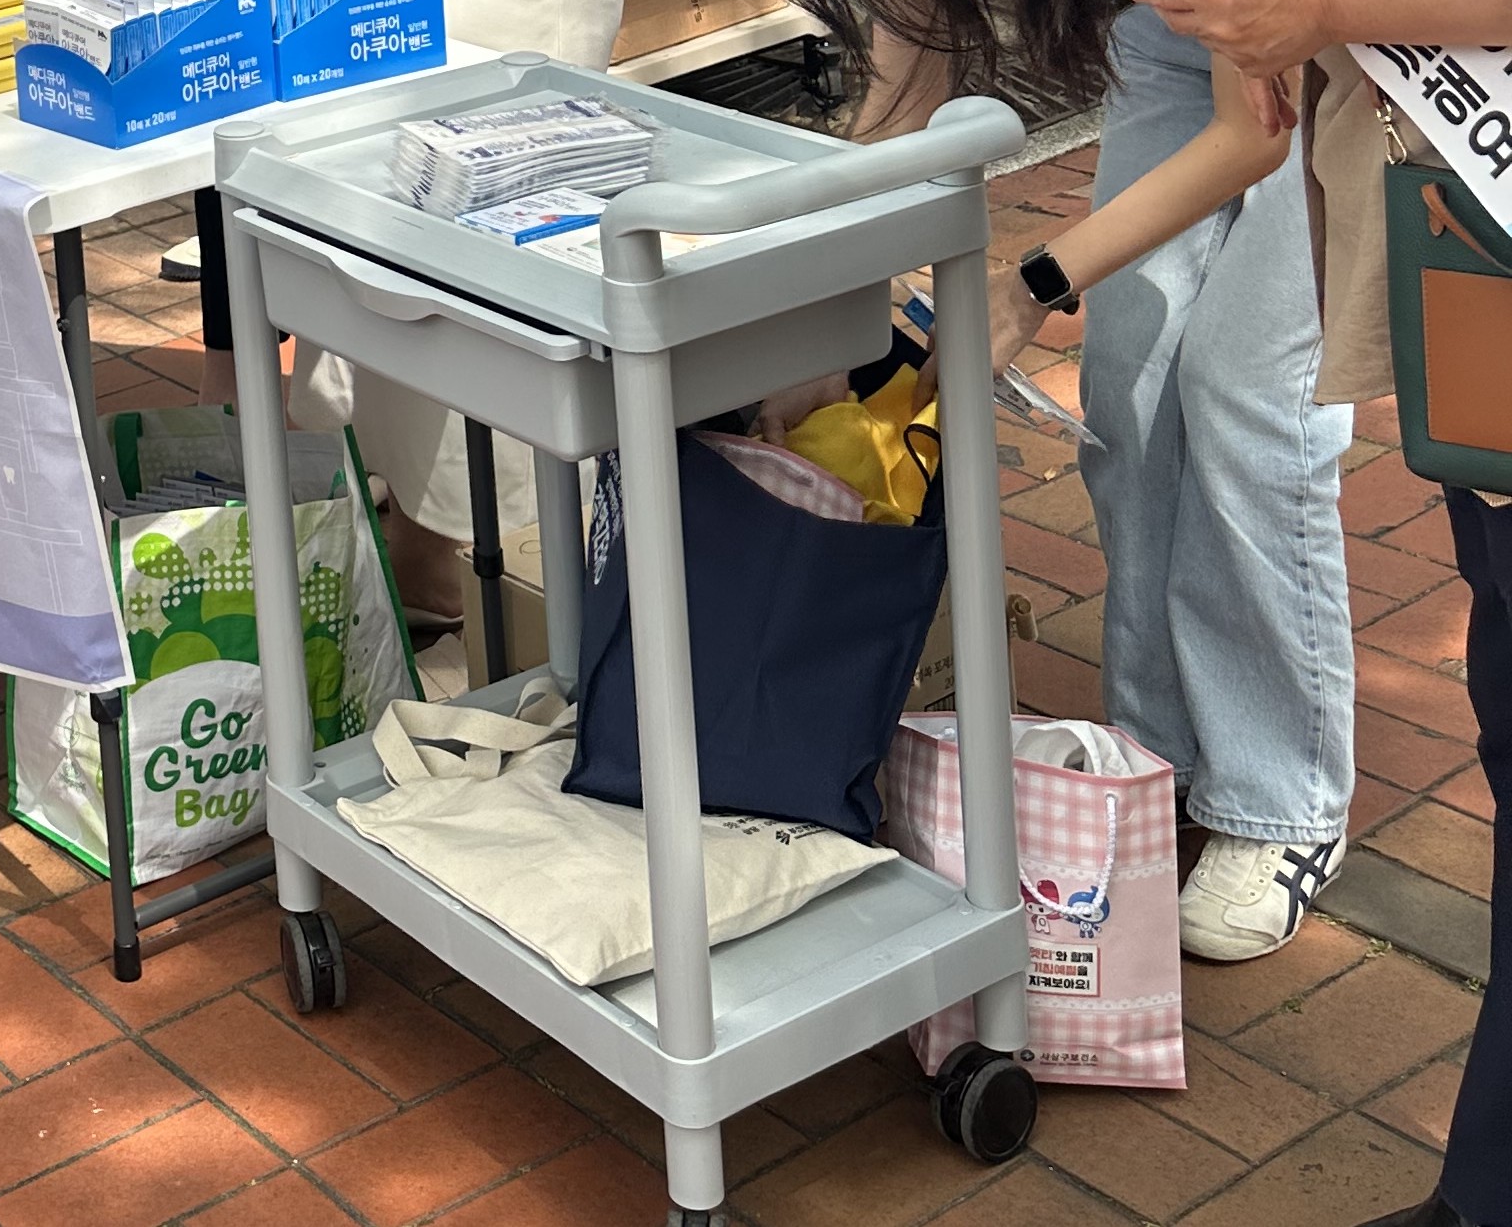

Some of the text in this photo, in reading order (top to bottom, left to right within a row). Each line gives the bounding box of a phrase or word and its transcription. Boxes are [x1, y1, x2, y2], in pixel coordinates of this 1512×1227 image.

[350, 13, 400, 38] 메디큐어
[27, 63, 67, 88] 메디큐어
[181, 51, 230, 78] 메디큐어
[181, 698, 253, 749] Go
[144, 744, 268, 792] Green
[175, 788, 260, 828] Bag
[1039, 1052, 1098, 1062] 사상구보건소
